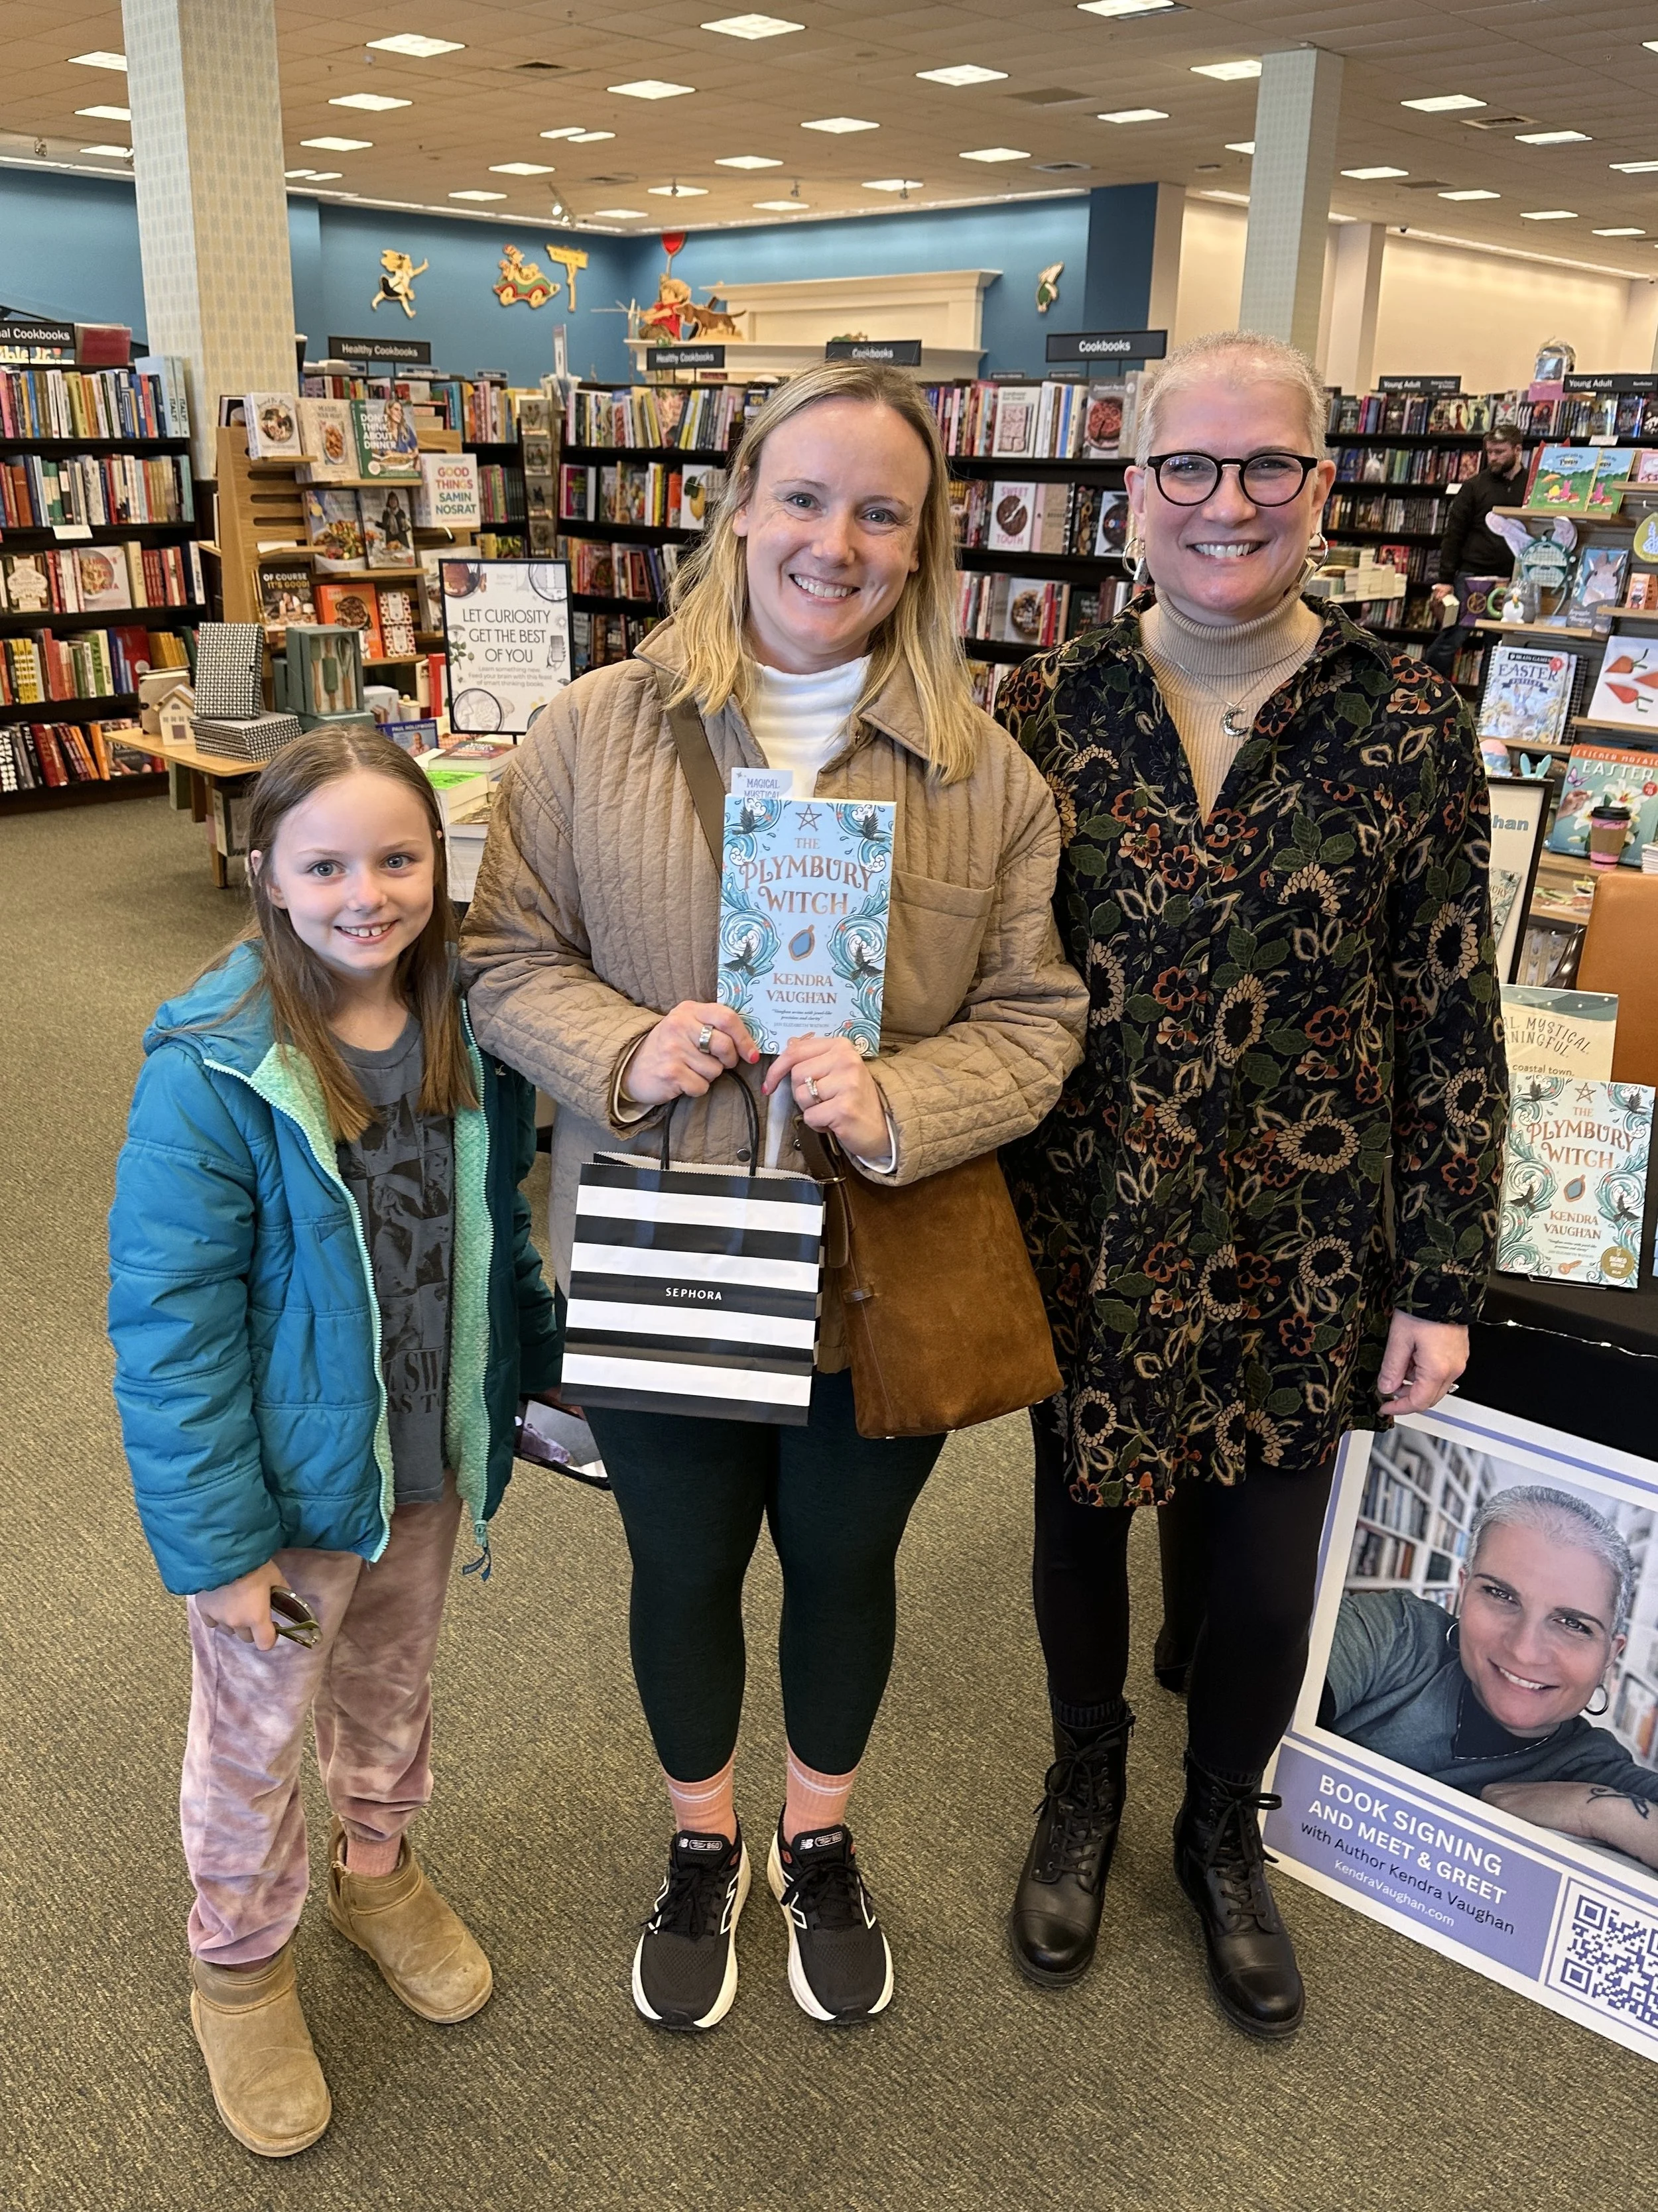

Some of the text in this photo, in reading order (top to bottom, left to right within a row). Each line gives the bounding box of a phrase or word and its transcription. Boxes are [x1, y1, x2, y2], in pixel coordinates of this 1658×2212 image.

[13, 328, 70, 341] Cookbooks
[342, 343, 418, 357] Healthy Cookbooks
[1079, 339, 1130, 352] Cookbooks
[1383, 381, 1403, 390] Young
[1569, 379, 1612, 389] Young Adult
[361, 423, 389, 432] THINK
[363, 432, 393, 440] ABOUT
[364, 440, 397, 450] DINNER
[438, 466, 469, 477] GOOD
[436, 479, 473, 489] THINGS
[439, 493, 472, 502] SAMIN
[1001, 487, 1029, 496] SWEET
[436, 505, 476, 515] NOSRAT
[996, 534, 1023, 544] TOOTH
[462, 609, 550, 623] LET CURIOSITY
[469, 628, 546, 643] GET THE BEST
[485, 648, 533, 662] OF YOU
[1499, 664, 1559, 682] EASTER
[1576, 749, 1617, 760] STICKER
[1582, 760, 1654, 781] EASTER
[794, 837, 820, 849] THE
[739, 855, 875, 892] PLYMBURY
[757, 886, 849, 914] WITCH
[773, 973, 833, 987] KENDRA
[766, 990, 837, 1004] VAUGHAN
[1512, 1064, 1575, 1076] coastal town.
[1573, 1107, 1593, 1117] THE
[1527, 1119, 1635, 1152] PLYMBURY
[1541, 1142, 1614, 1169] WITCH
[1550, 1210, 1598, 1225] KENDRA
[1543, 1223, 1602, 1239] VAUGHAN
[665, 1287, 722, 1300] SEPHORA
[1318, 1774, 1503, 1876] BOOK SIGNING
[1308, 1800, 1507, 1905] AND MEET & GREET
[1301, 1821, 1515, 1936] with Author Kendra Vaughan
[1335, 1859, 1455, 1928] KendraVaughan.com
